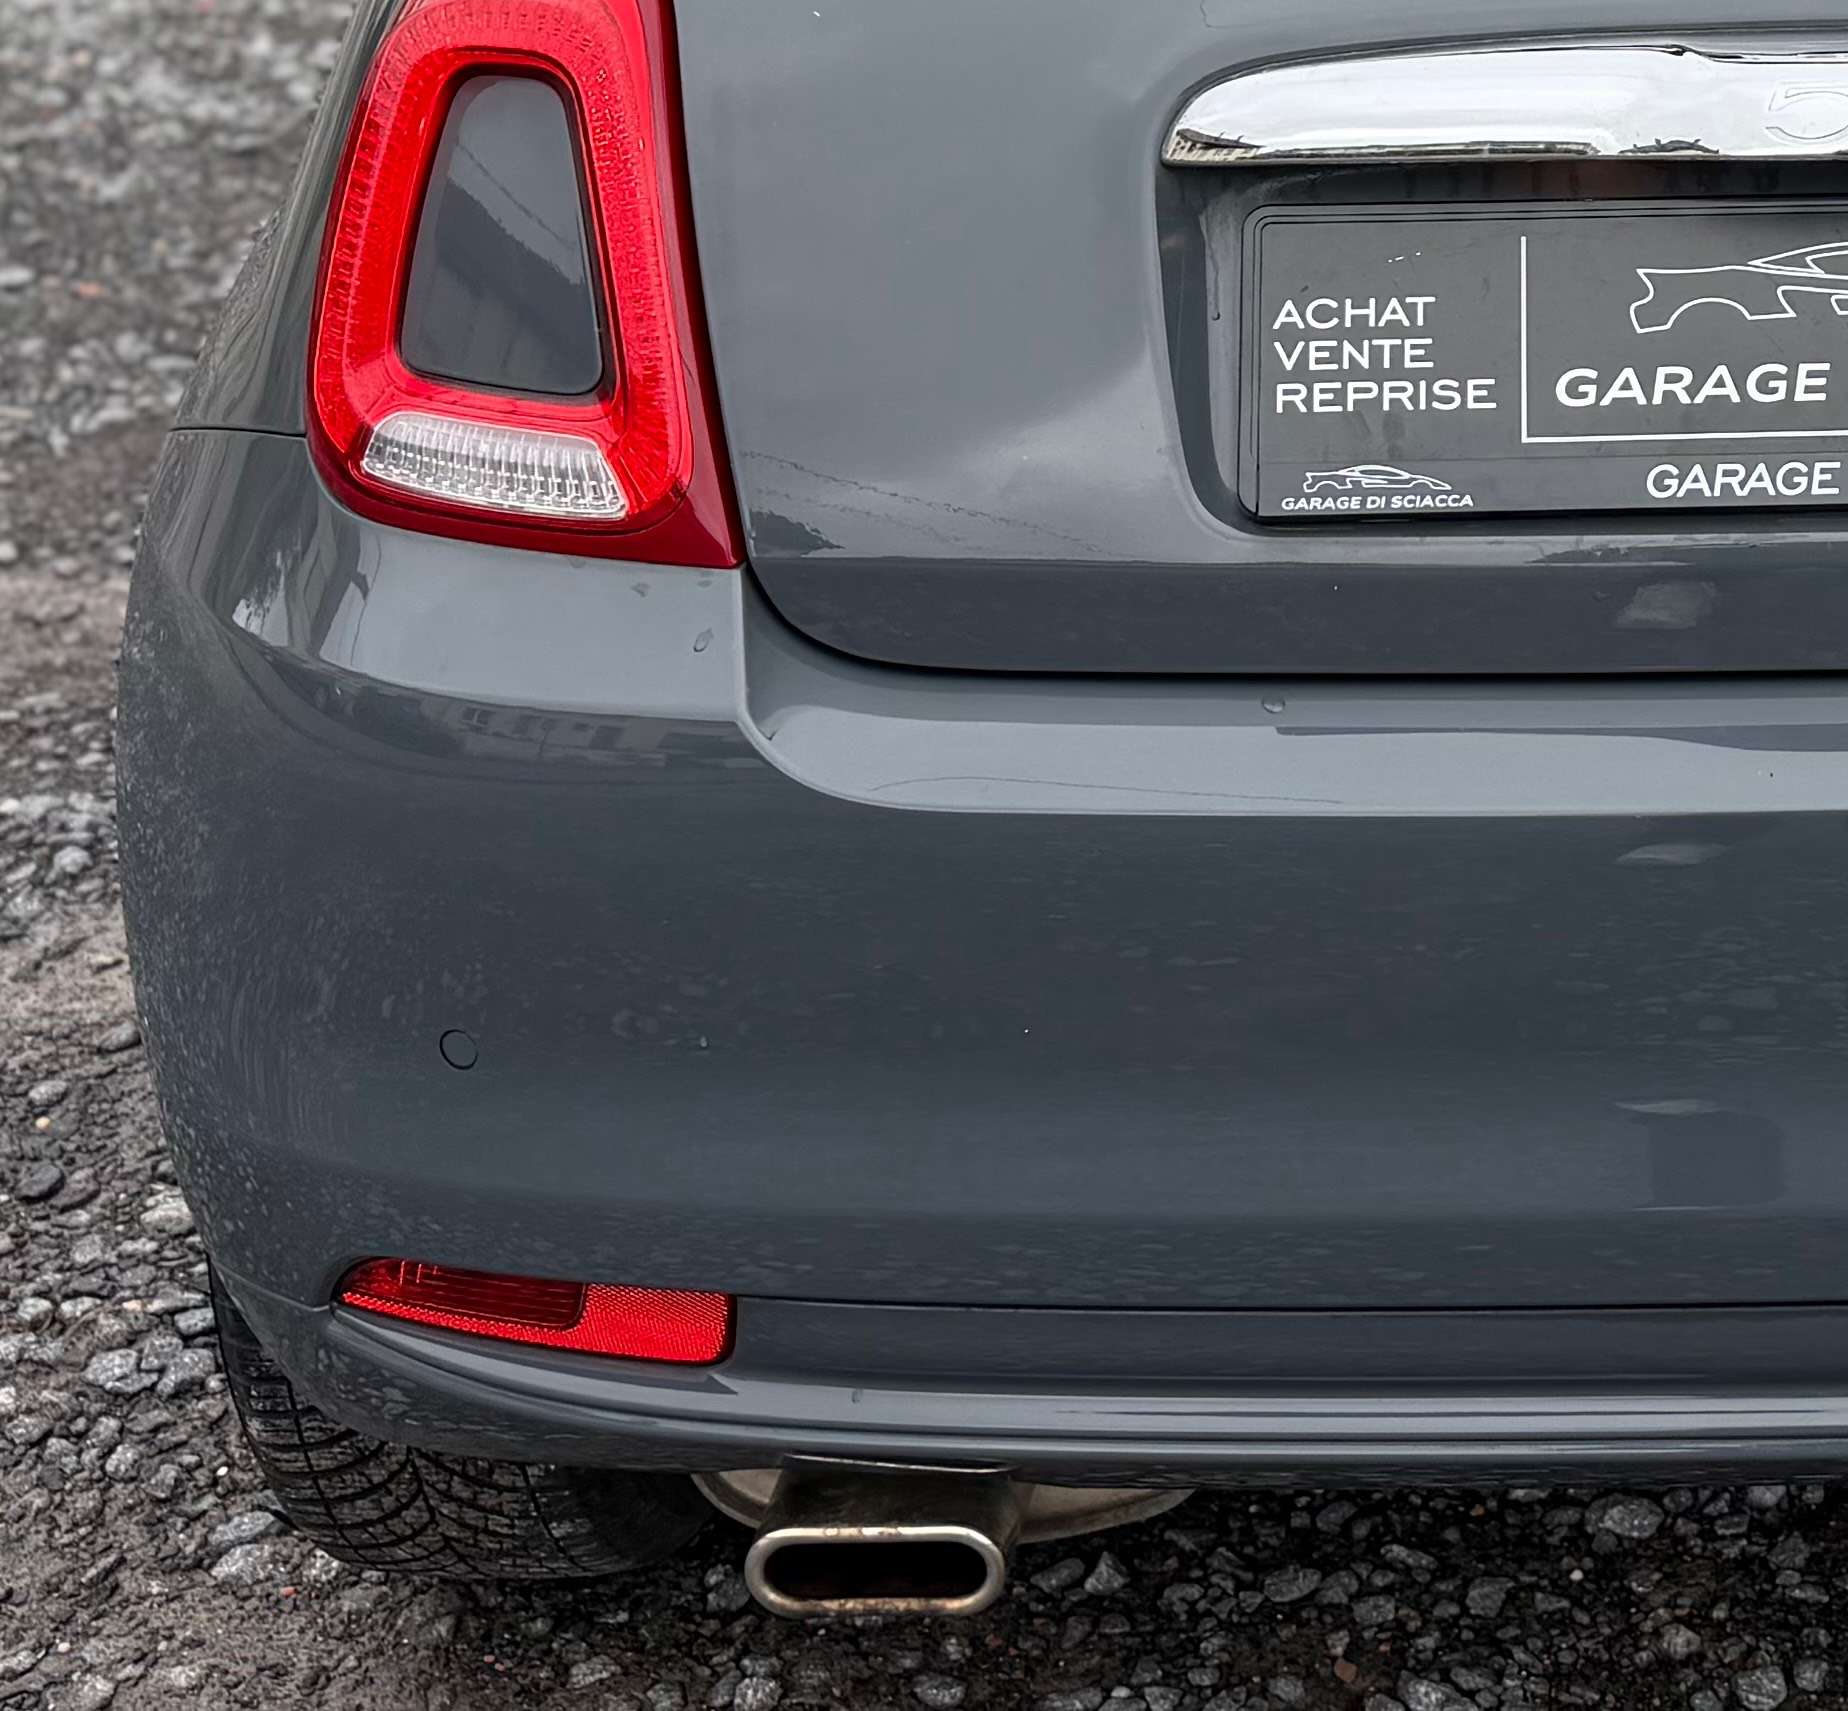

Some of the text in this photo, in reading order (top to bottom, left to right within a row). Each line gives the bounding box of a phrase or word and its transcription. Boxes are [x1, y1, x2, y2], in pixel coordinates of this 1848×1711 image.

[1272, 296, 1436, 330] ACHAT
[1273, 337, 1435, 371] VENTE
[1275, 378, 1498, 414] REPRISE
[1554, 361, 1832, 408] GARAGE
[1645, 461, 1841, 499] GARAGE
[1281, 494, 1475, 511] GARAGE DI SCIACCA
